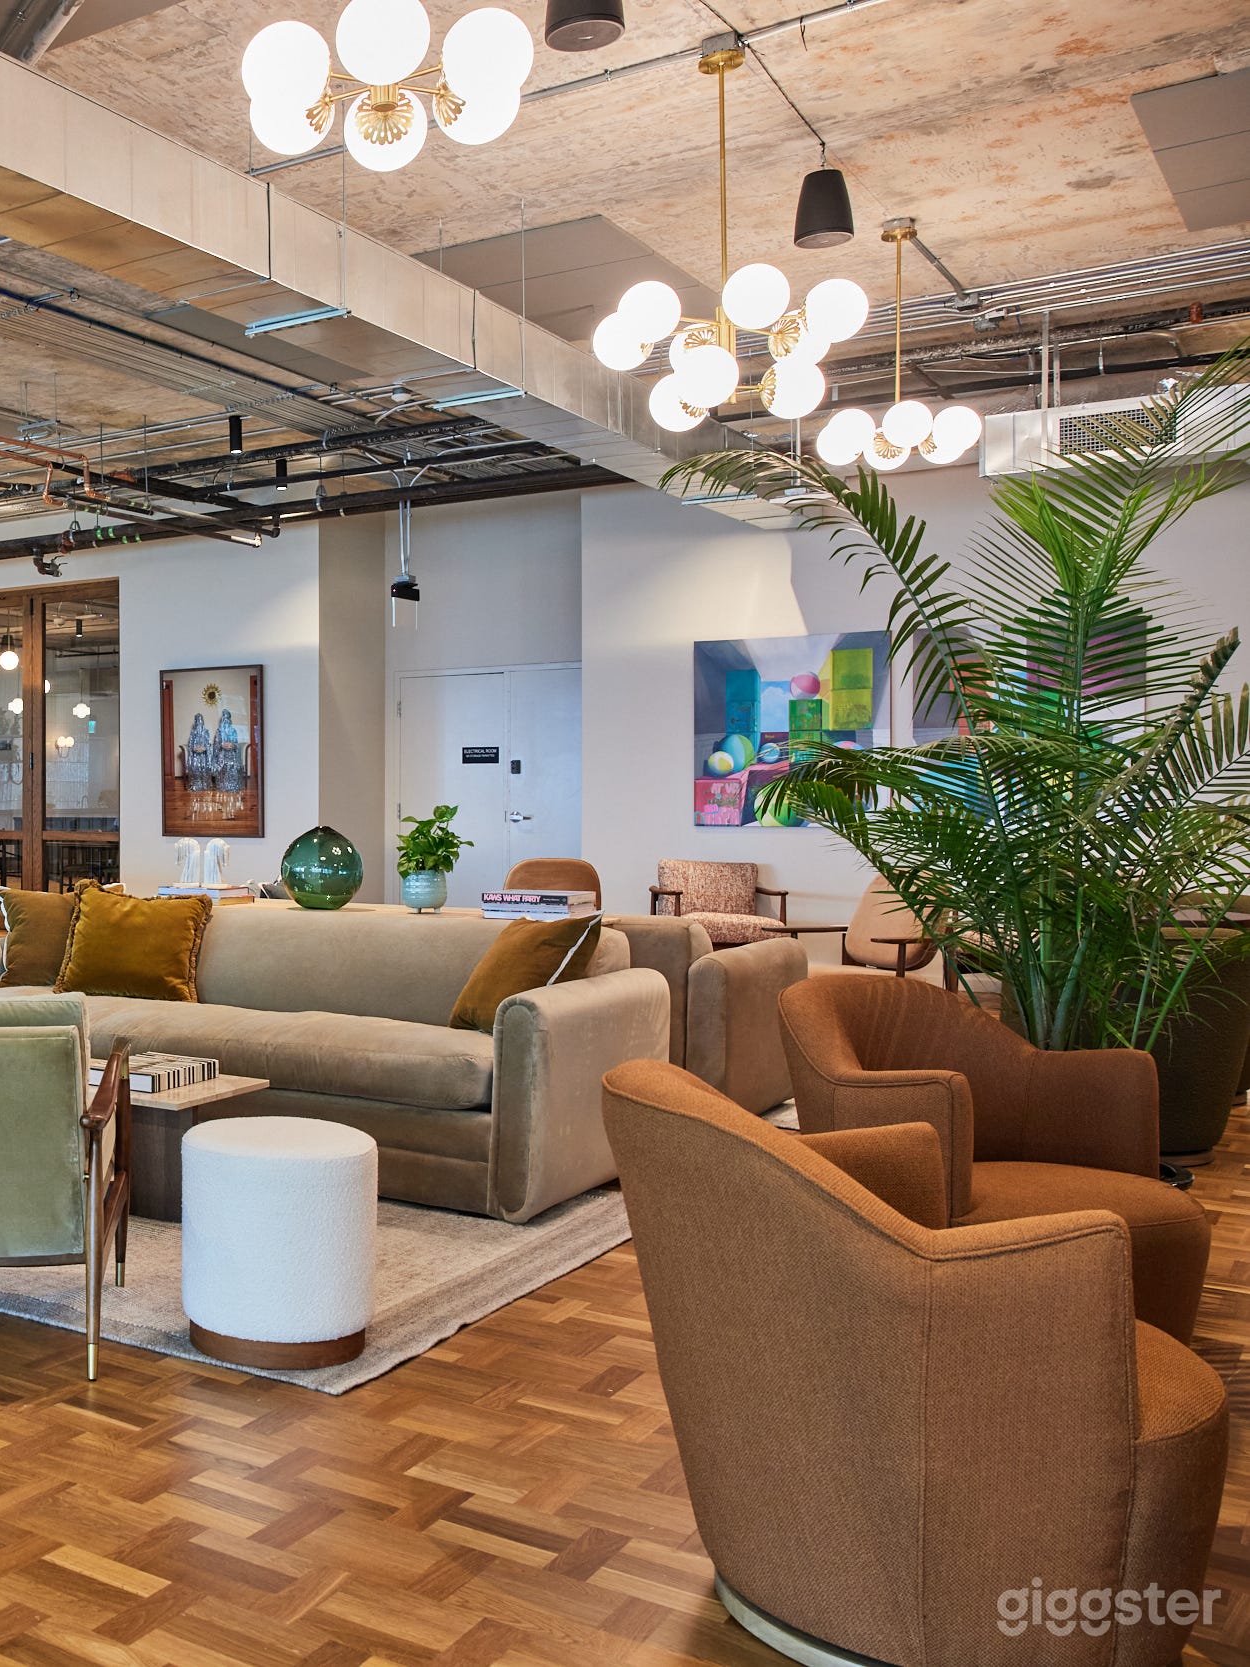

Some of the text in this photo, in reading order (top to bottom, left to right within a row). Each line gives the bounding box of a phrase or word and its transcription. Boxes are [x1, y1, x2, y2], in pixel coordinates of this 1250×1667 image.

[483, 893, 502, 901] KAWS
[503, 894, 522, 902] WHAT
[522, 895, 541, 903] PARTY
